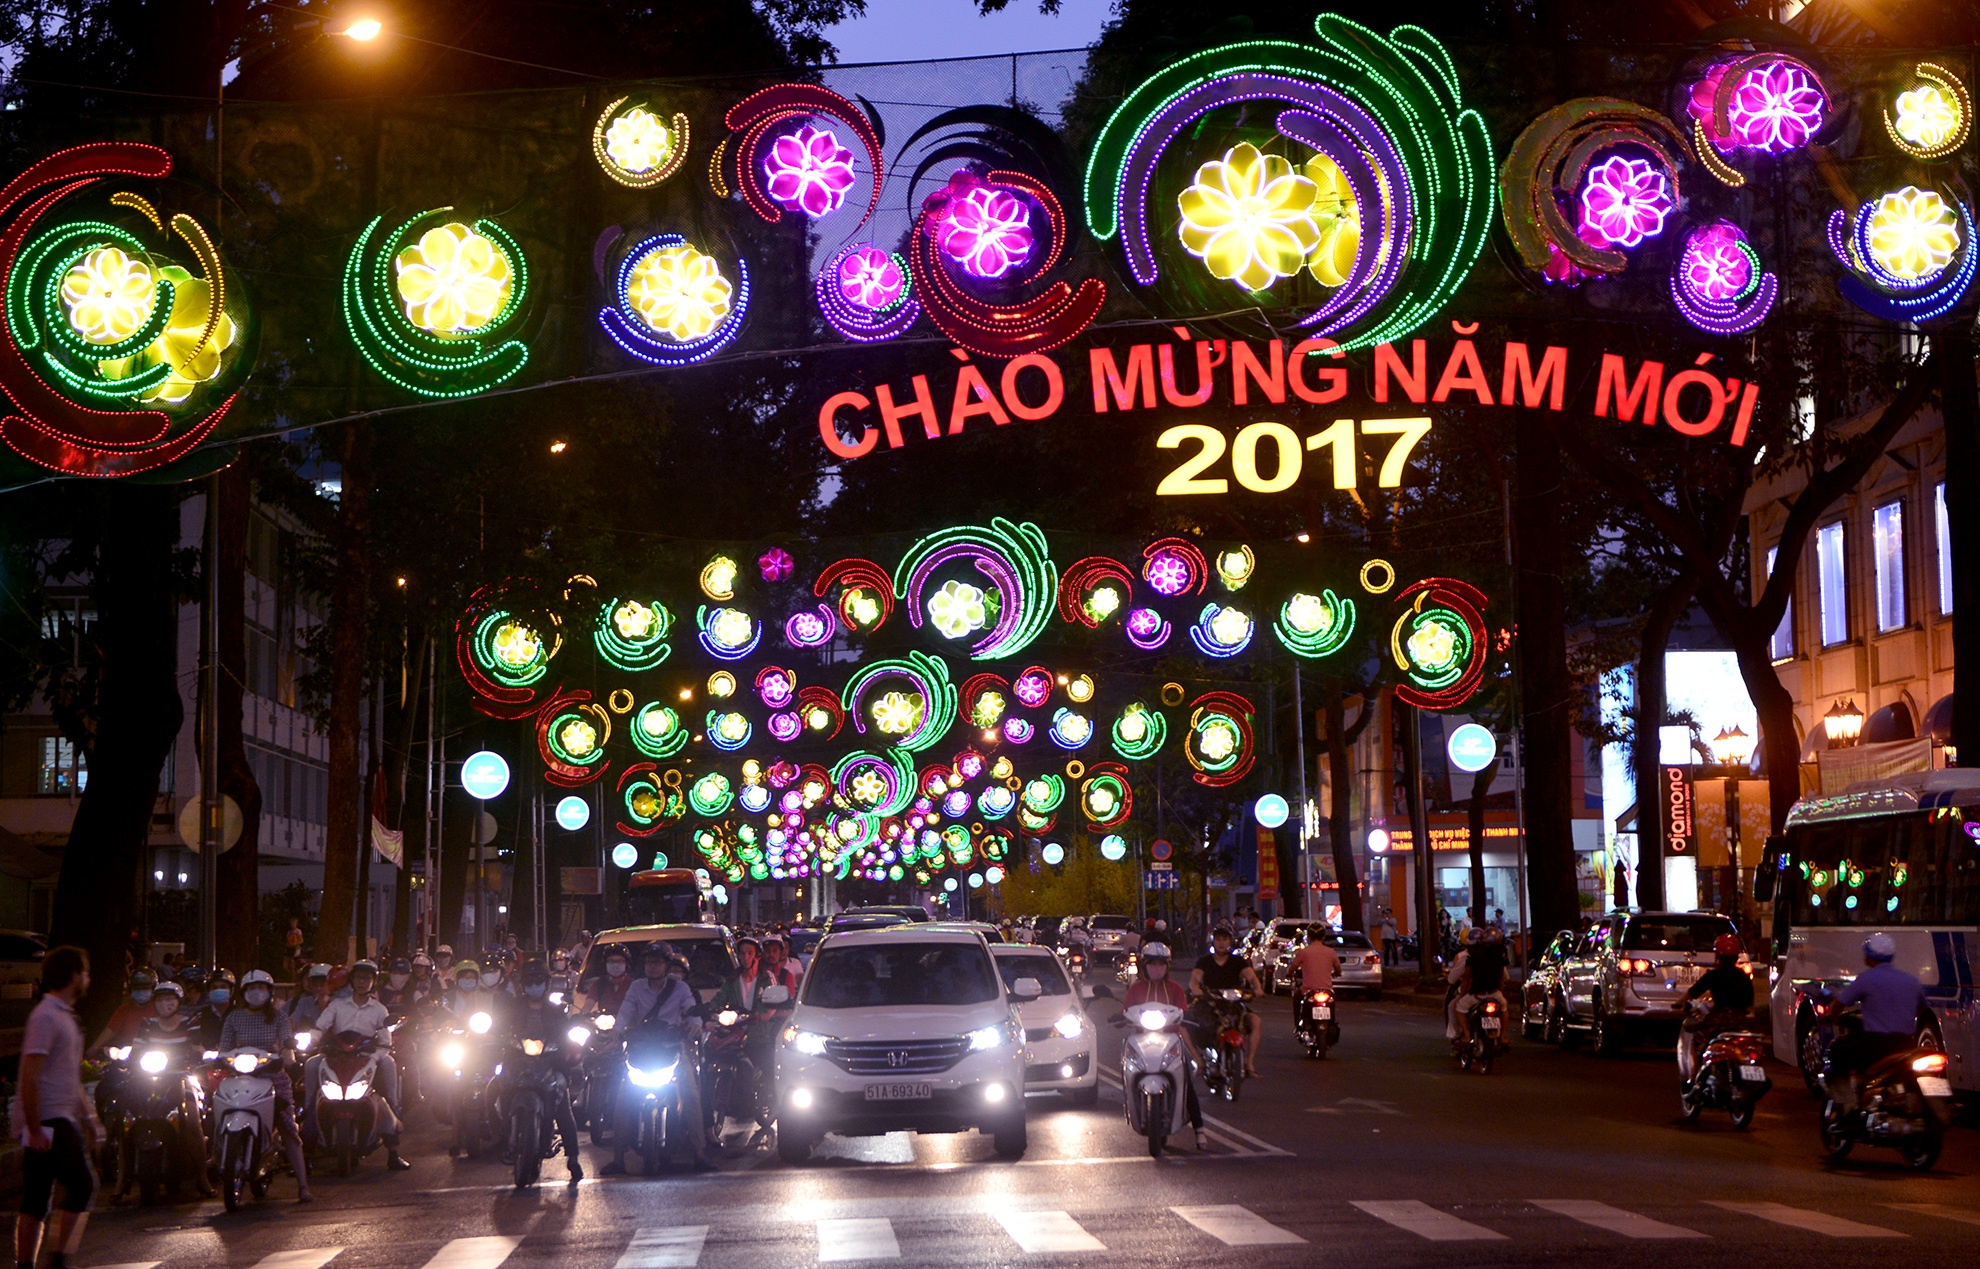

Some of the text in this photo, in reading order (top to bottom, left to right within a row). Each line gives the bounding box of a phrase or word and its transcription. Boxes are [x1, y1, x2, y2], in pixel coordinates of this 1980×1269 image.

[818, 320, 1760, 460] CHÀO MỪNG NĂM MỚI
[1155, 416, 1433, 496] 2017
[1391, 830, 1413, 840] TRUNG
[1486, 828, 1508, 837] THANH
[1391, 840, 1414, 851] THÀNH
[1451, 840, 1470, 850] MINH
[1667, 767, 1687, 852] diamond
